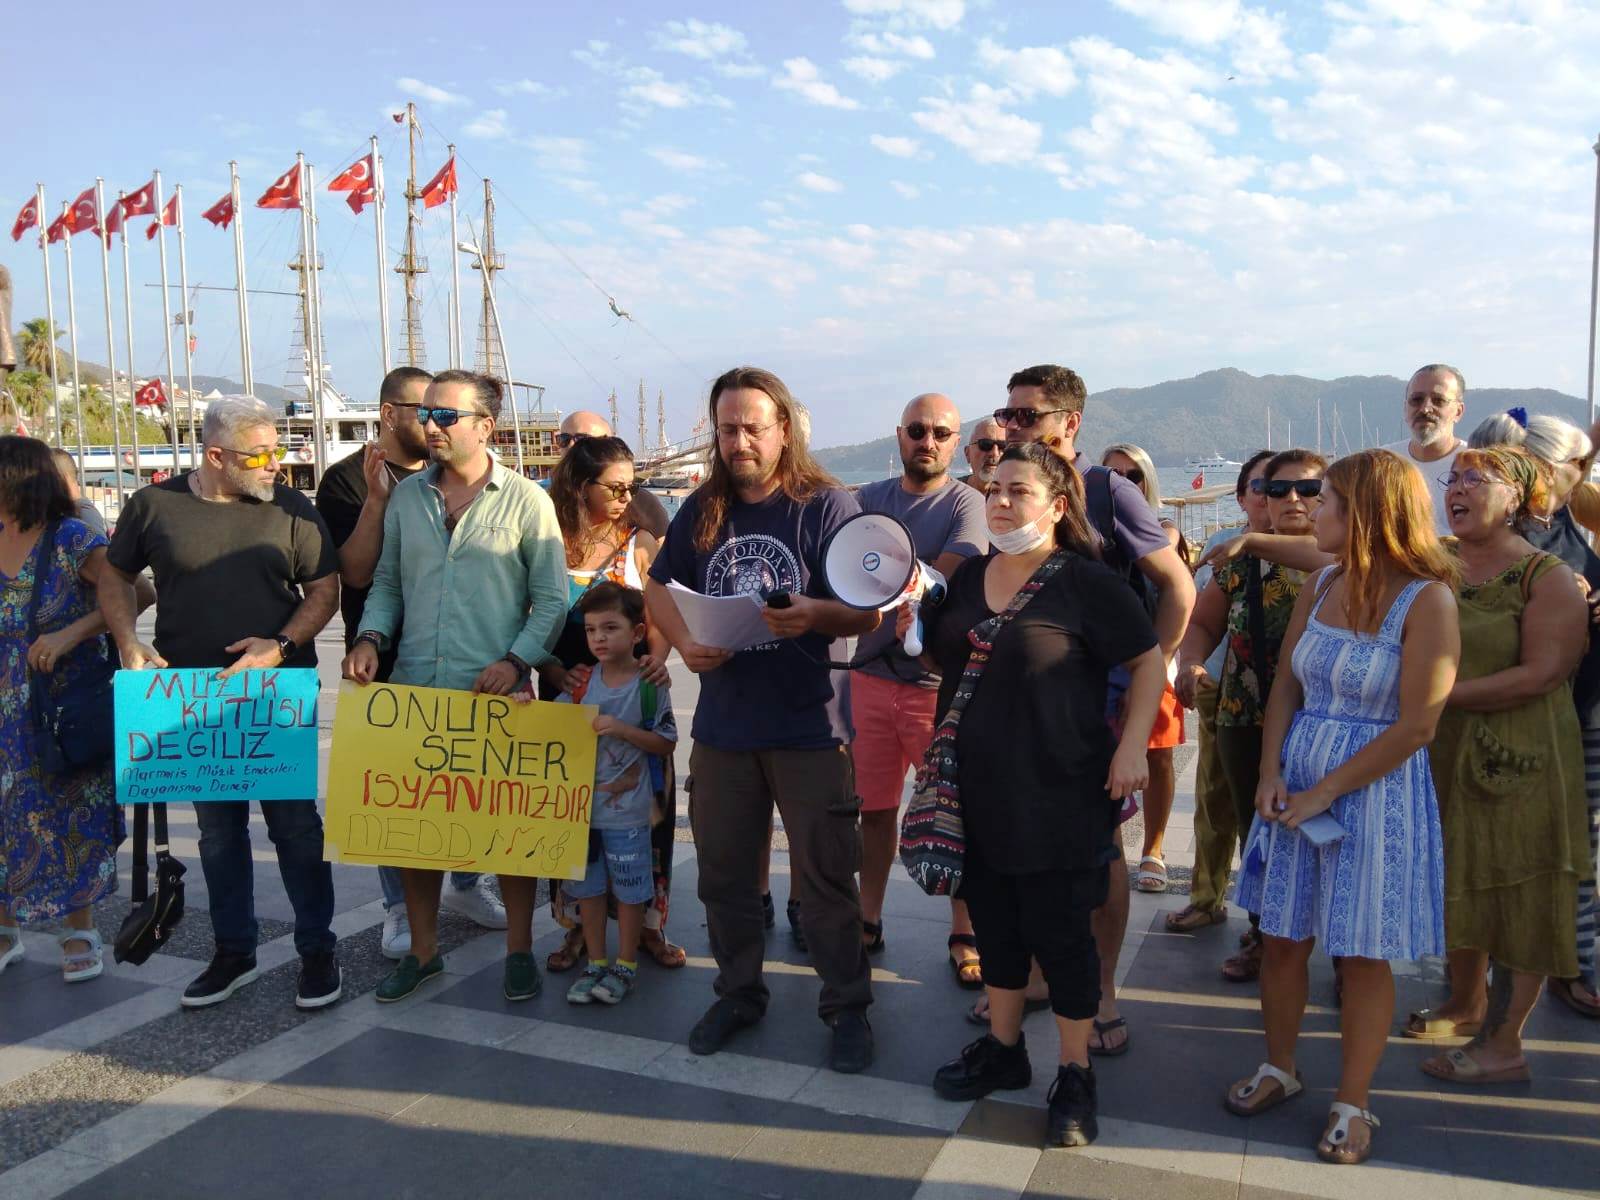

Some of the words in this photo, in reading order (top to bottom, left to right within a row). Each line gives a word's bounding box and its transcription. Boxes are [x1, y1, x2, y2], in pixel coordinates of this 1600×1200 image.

[717, 542, 784, 571] FLORIDA
[755, 643, 780, 651] KEY
[182, 697, 317, 731] KUTUSU
[367, 687, 516, 738] ONUR
[415, 735, 569, 781] ŞENER
[347, 813, 473, 858] MEDD
